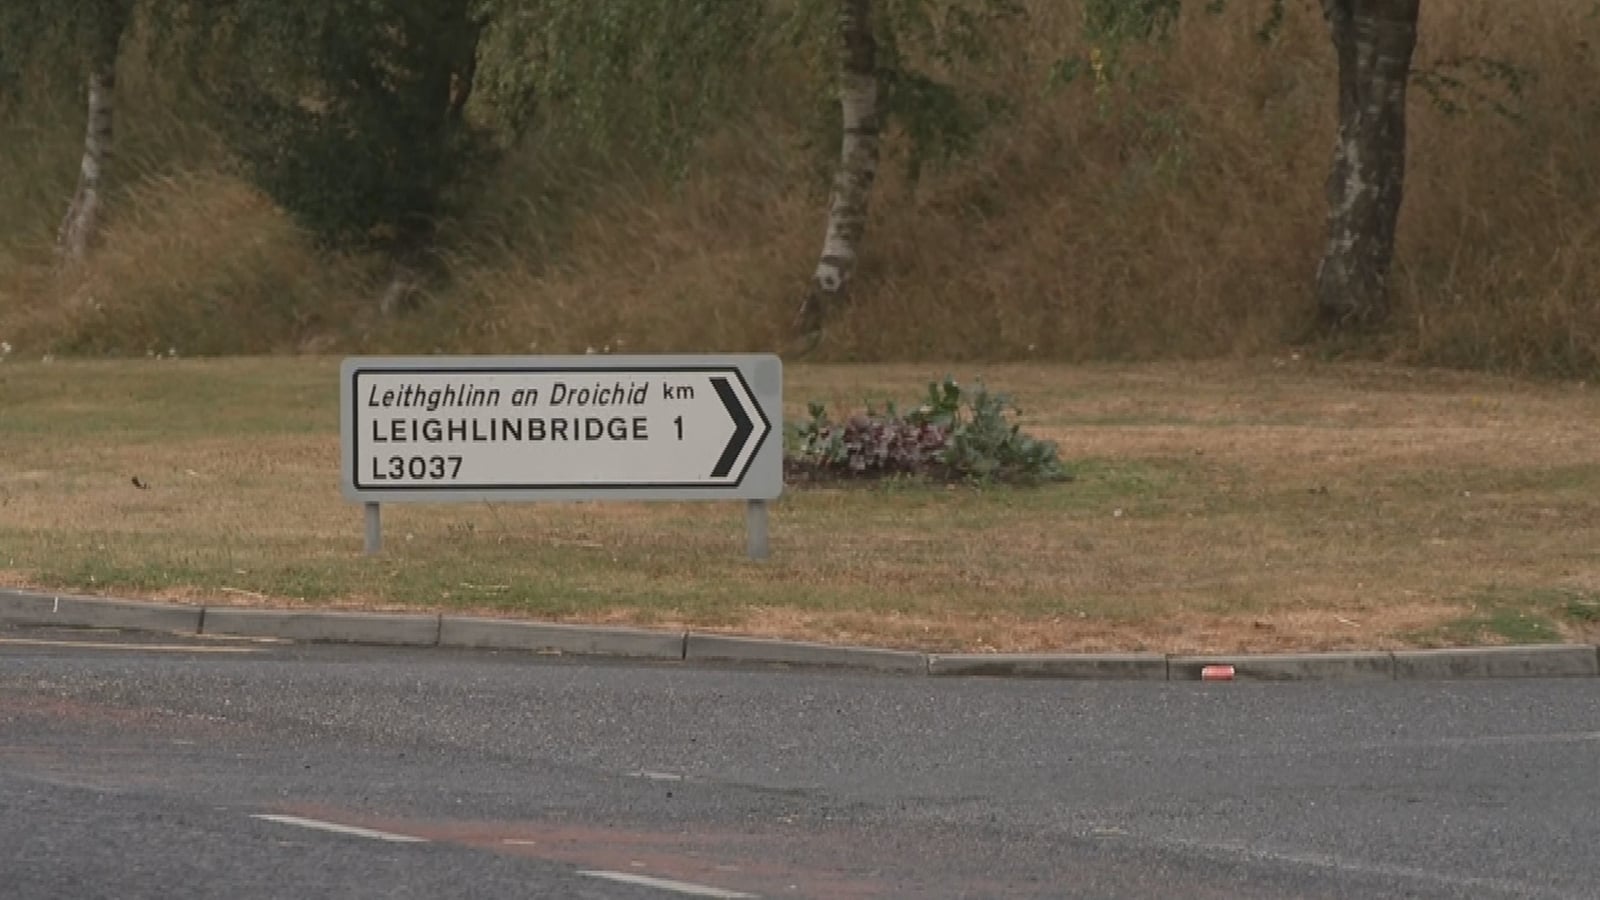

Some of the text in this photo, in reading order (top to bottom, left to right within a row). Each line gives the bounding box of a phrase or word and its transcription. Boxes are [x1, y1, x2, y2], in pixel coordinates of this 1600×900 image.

[368, 381, 695, 411] Leithghlinn an Droichid km
[372, 416, 684, 442] LEIGHLINBRIDGE 1
[372, 455, 463, 480] L3037
